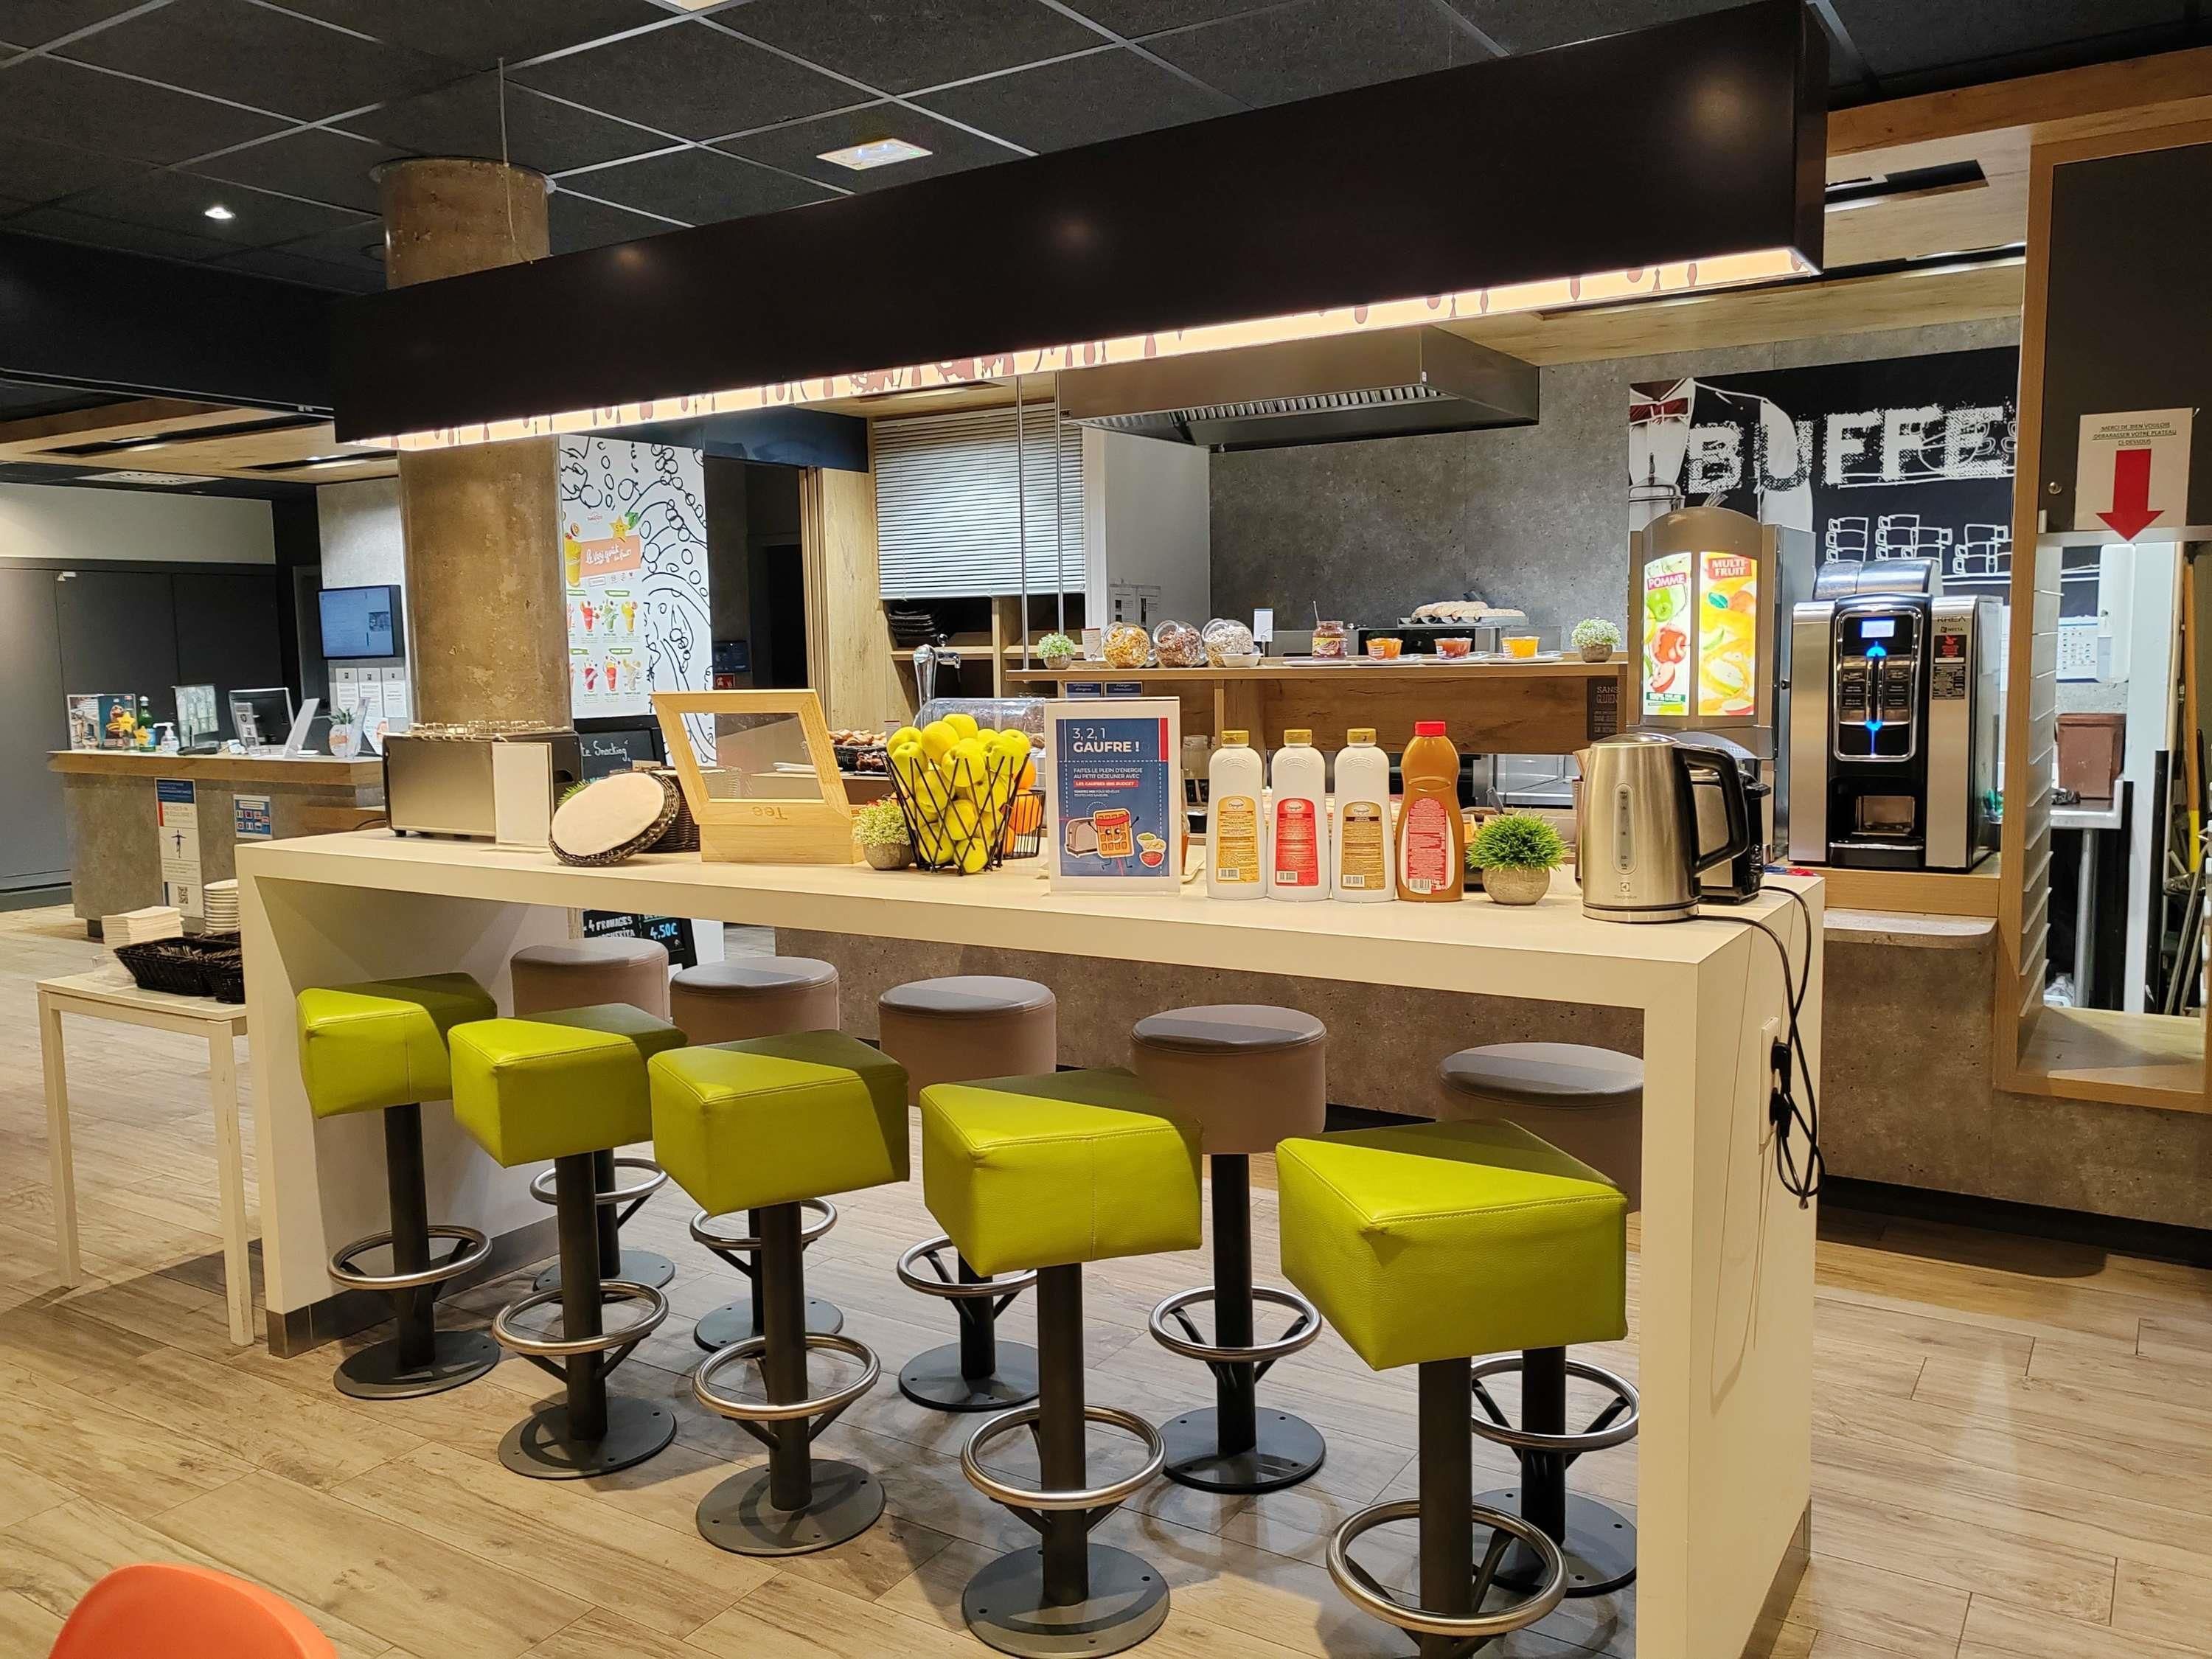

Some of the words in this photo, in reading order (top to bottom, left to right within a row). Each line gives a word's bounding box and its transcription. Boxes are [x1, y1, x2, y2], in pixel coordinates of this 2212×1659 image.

[2144, 421, 2170, 429] VOULOIR
[1687, 404, 2006, 494] BUFFE
[1711, 557, 1748, 568] MULTI-
[1714, 567, 1746, 576] FRUIT
[1648, 574, 1685, 588] POMME
[1072, 728, 1083, 740] 3,
[1086, 728, 1097, 740] 2,
[1100, 728, 1106, 739] 1
[1073, 741, 1132, 753] GAUFRE
[1135, 741, 1140, 752] !
[588, 919, 595, 932] 4
[596, 916, 633, 931] FROMAGES
